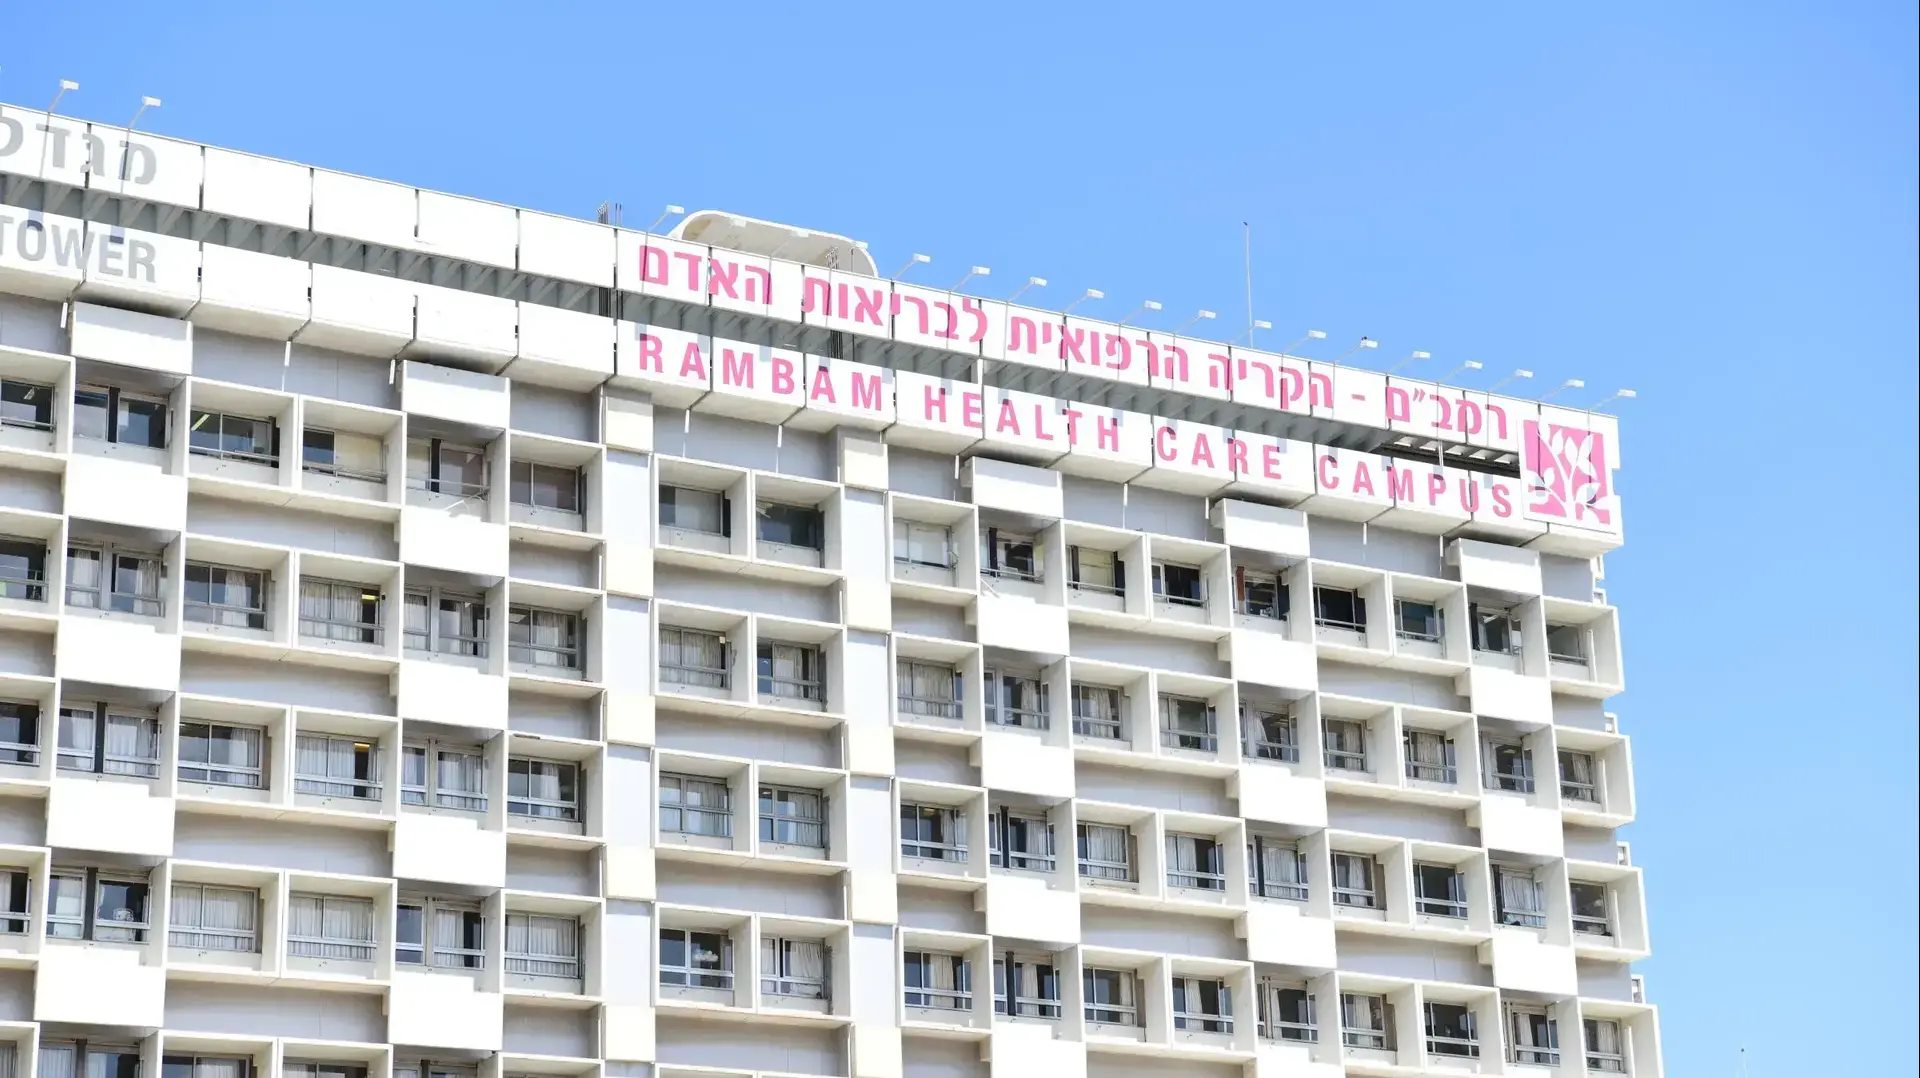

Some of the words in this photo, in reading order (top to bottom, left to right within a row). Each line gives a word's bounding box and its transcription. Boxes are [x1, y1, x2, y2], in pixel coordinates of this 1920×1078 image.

[639, 245, 773, 305] האדם
[801, 276, 988, 343] לבריאות
[1008, 316, 1189, 382] הרפואית
[1208, 353, 1334, 410] הקריה
[639, 333, 882, 411] RAMBAM
[924, 385, 1119, 453] HEALTH
[1157, 426, 1282, 480] CARE
[1318, 454, 1512, 518] CAMPUS
